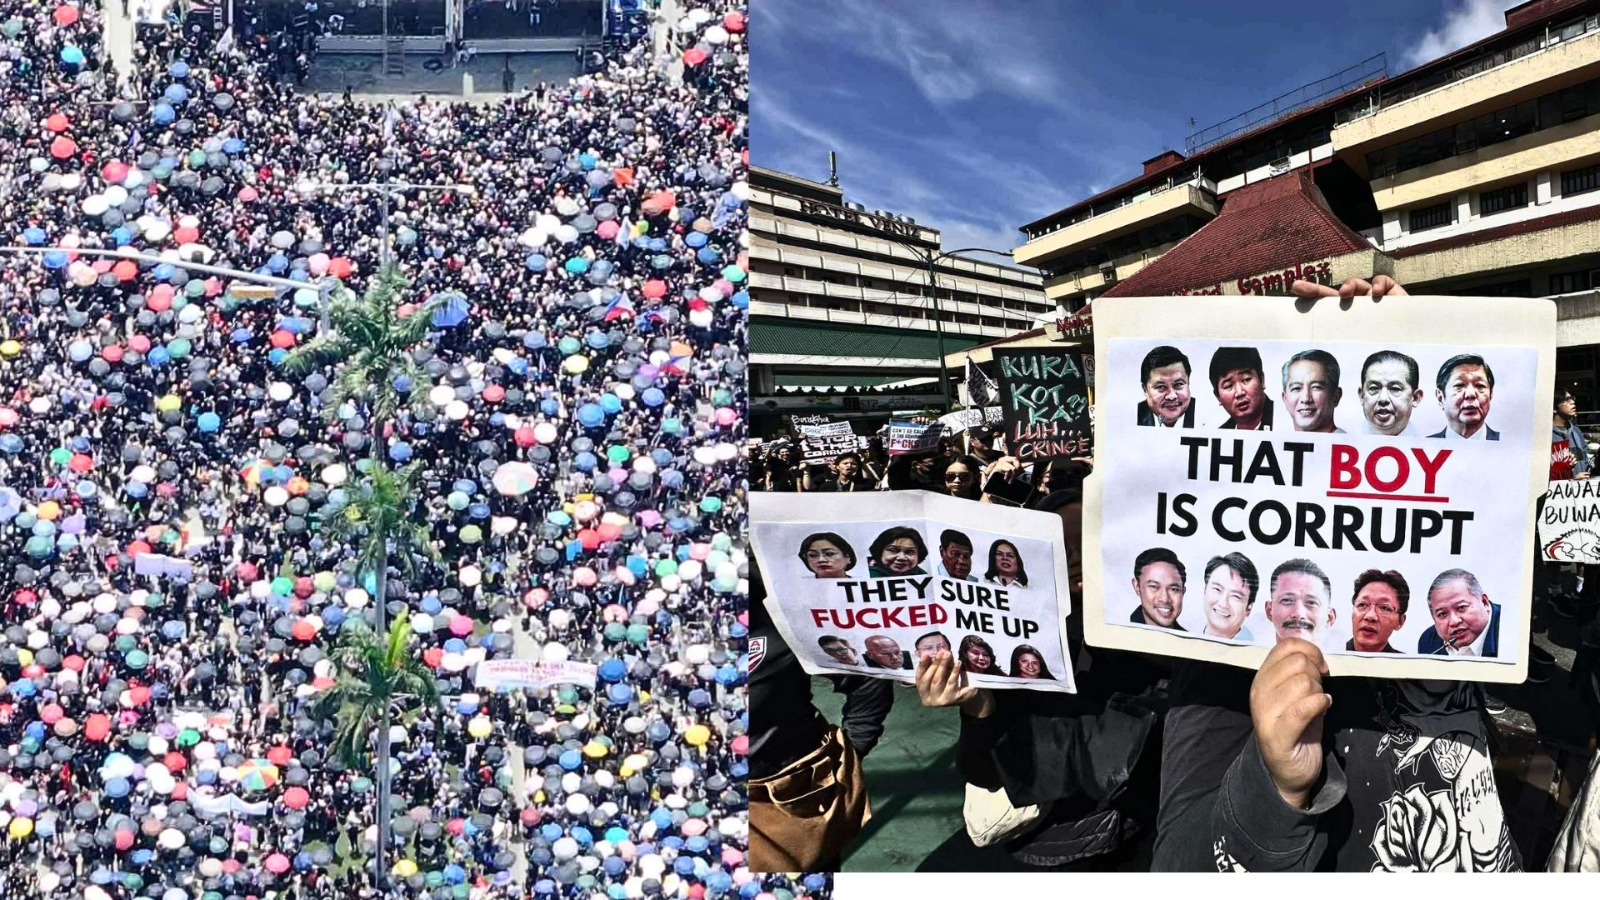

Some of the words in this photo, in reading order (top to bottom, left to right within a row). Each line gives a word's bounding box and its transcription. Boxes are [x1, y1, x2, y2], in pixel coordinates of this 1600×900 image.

[800, 200, 857, 223] HOTEL
[1237, 260, 1330, 295] Complex
[1001, 353, 1081, 379] KURA
[1010, 383, 1064, 410] KOT
[1017, 437, 1090, 459] CRINGE
[1180, 436, 1314, 487] THAT
[1329, 443, 1453, 494] BOY
[1156, 492, 1198, 537] IS
[1211, 496, 1475, 555] CORRUPT
[836, 576, 933, 603] THEY
[940, 580, 1010, 612] SURE
[810, 603, 948, 629] FUCKED
[955, 608, 995, 634] ME
[1002, 617, 1039, 640] UP
